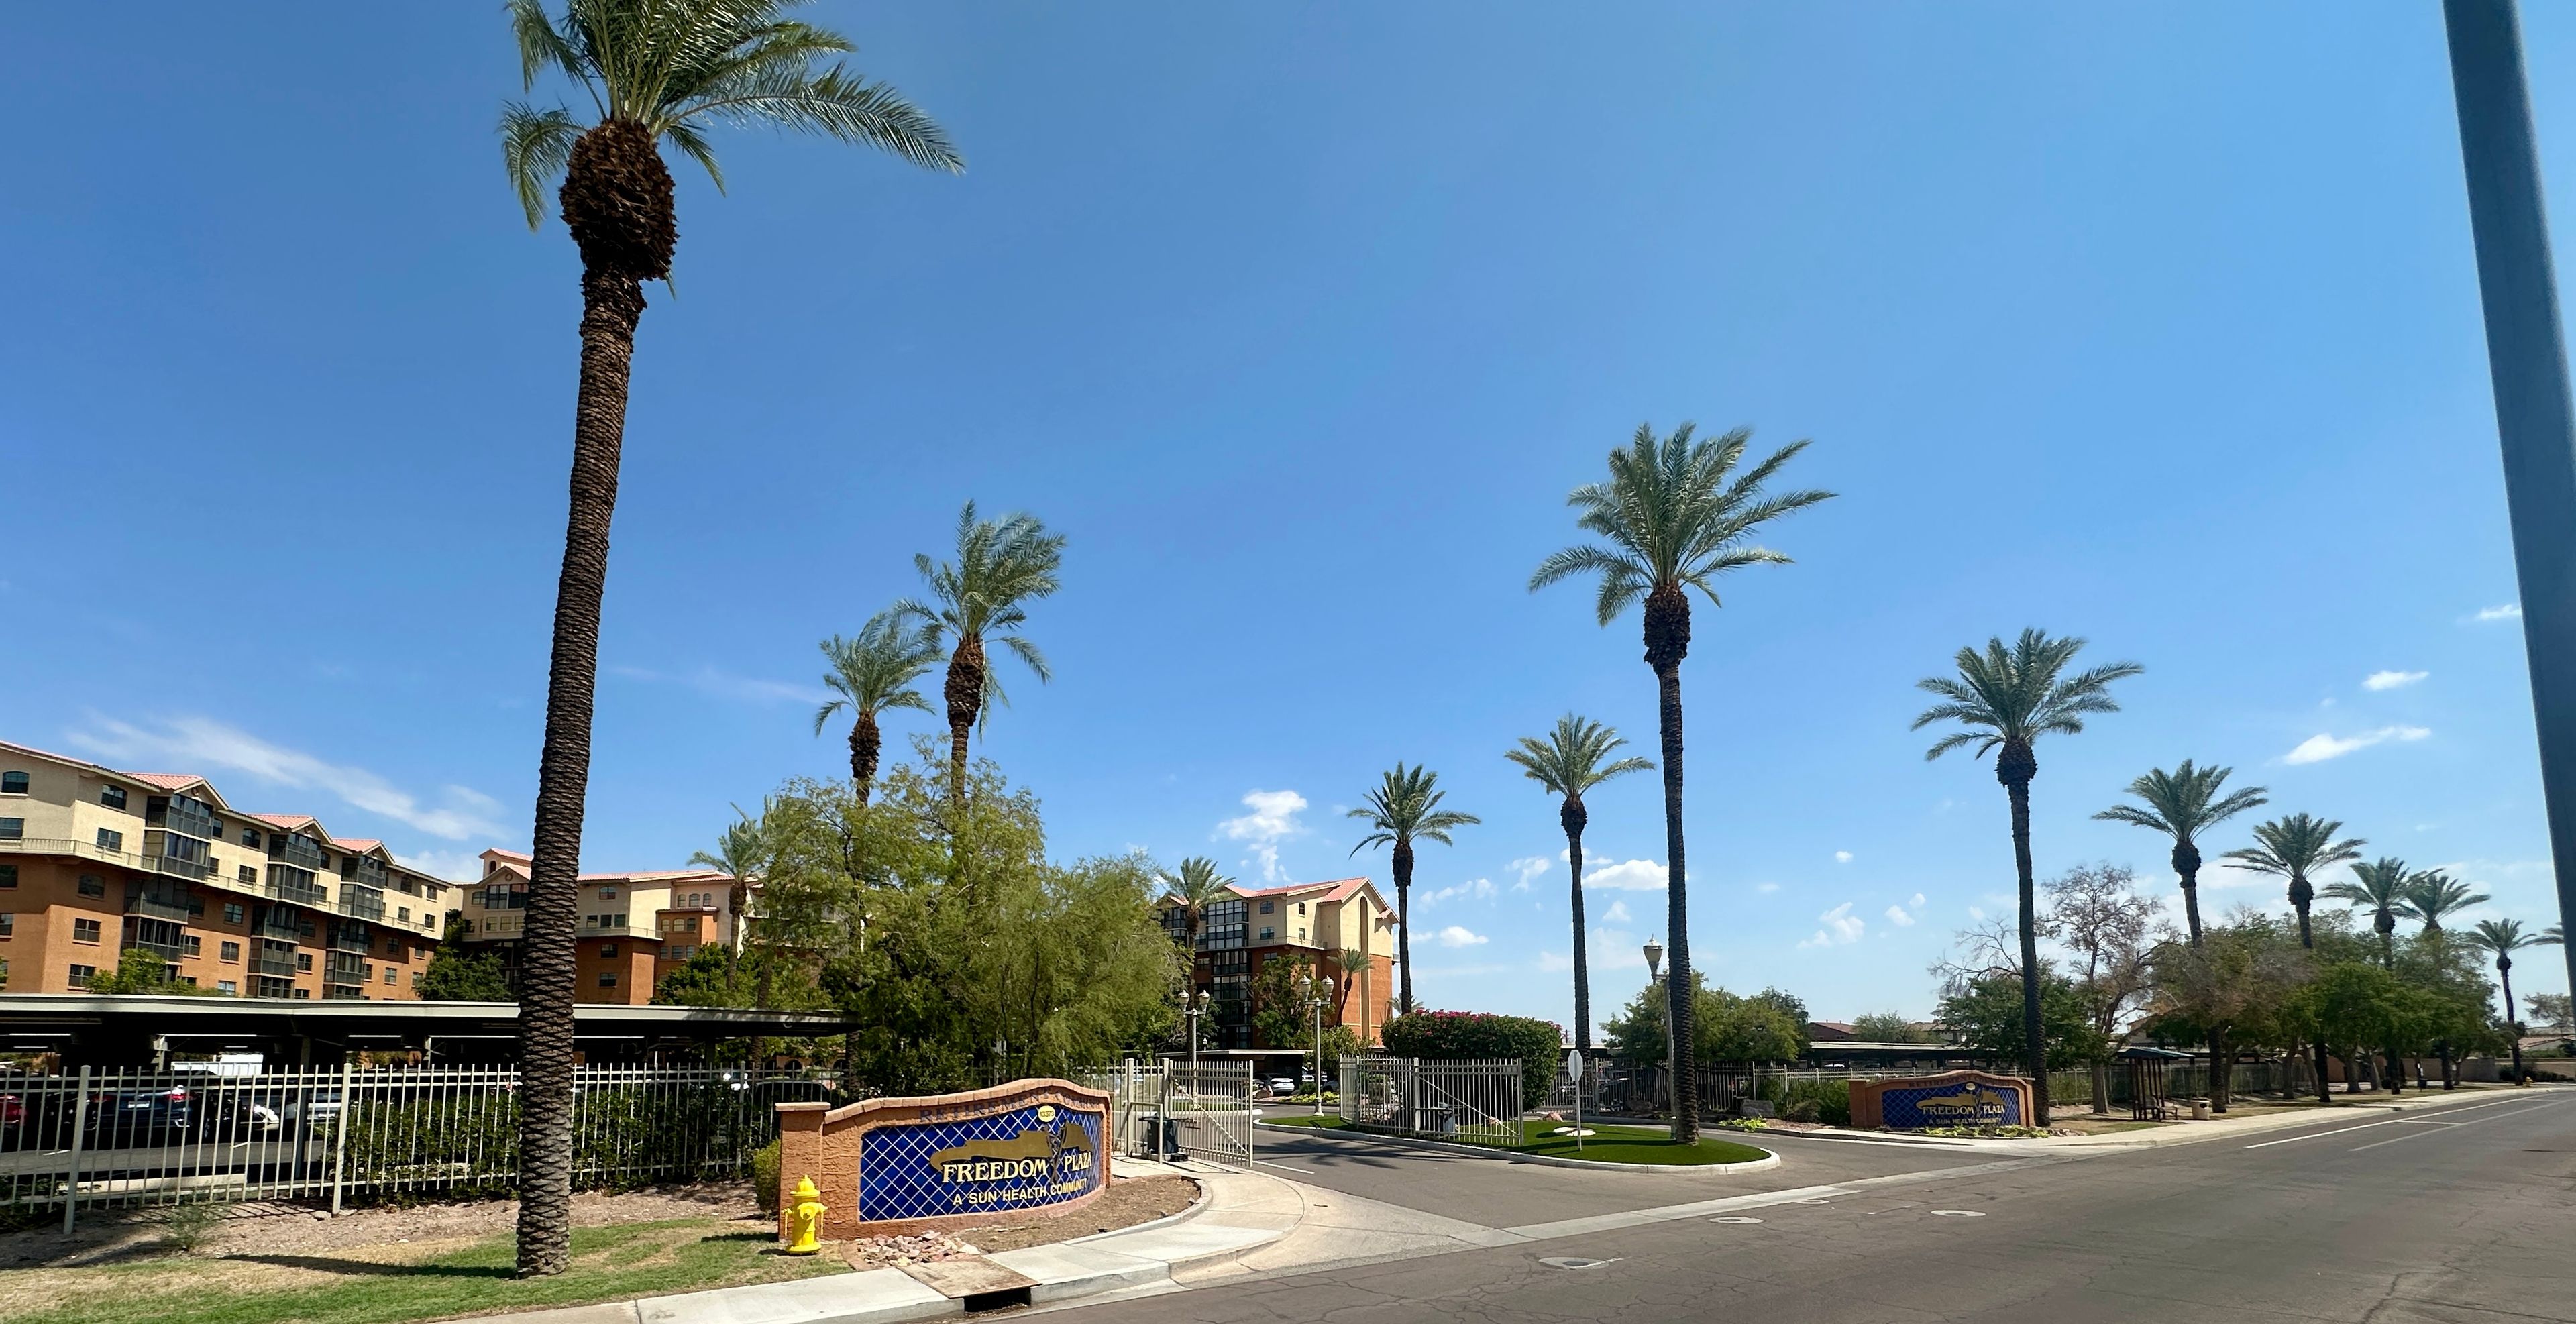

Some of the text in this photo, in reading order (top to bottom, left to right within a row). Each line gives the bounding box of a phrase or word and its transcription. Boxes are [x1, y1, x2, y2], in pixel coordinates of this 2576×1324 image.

[920, 1088, 1050, 1121] RETIREMENT
[1923, 1105, 2005, 1115] FREEDOM PLAZA
[942, 1151, 1093, 1183] FREEDOM PLAZA
[953, 1178, 1088, 1206] A SUN HEALTH COMMUNITY
